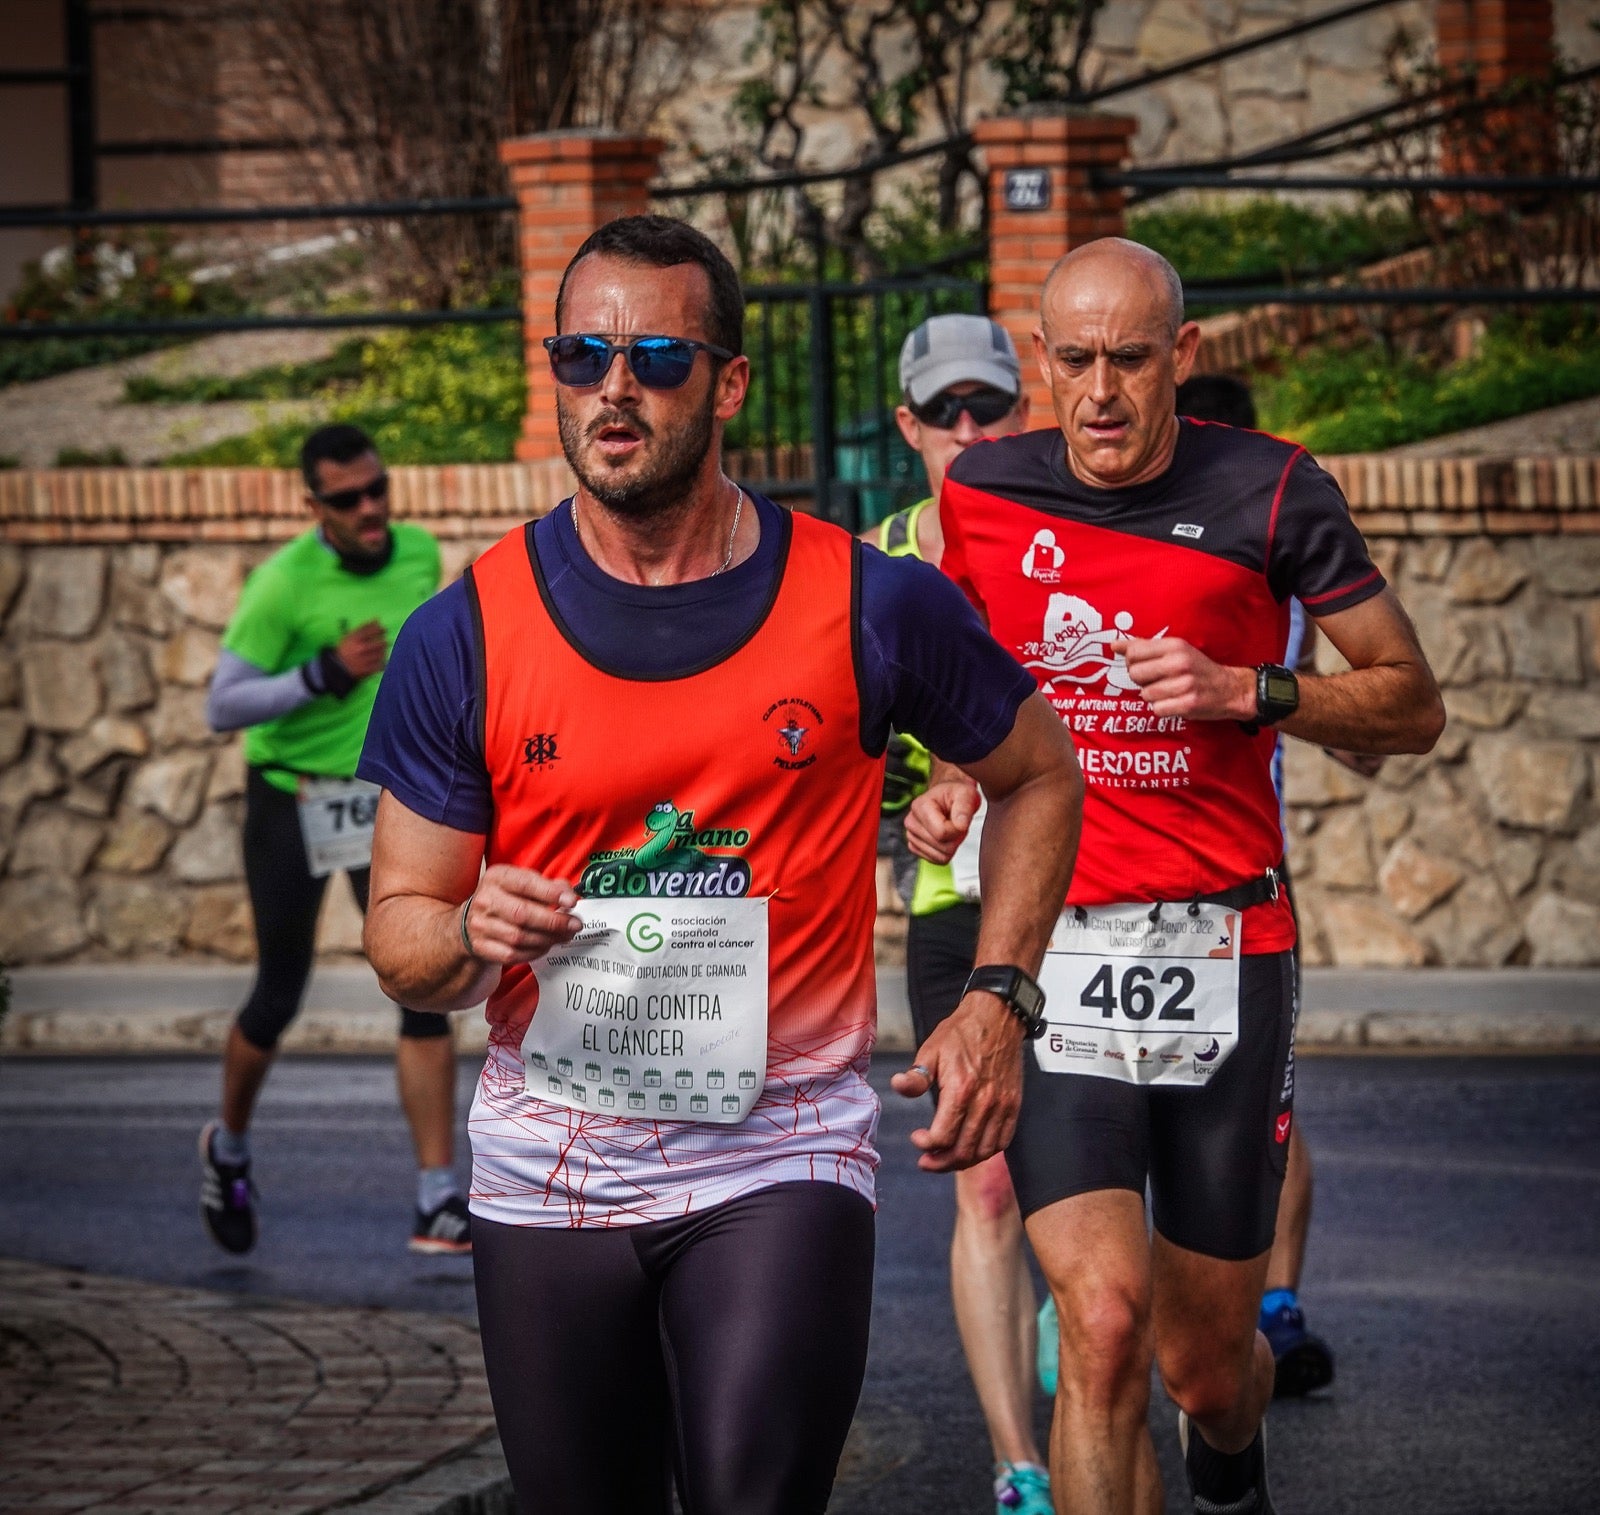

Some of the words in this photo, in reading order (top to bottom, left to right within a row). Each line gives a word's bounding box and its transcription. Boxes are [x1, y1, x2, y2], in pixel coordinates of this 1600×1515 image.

[1074, 714, 1098, 732] DE
[674, 828, 749, 849] mano
[589, 847, 636, 862] ocasión
[671, 915, 726, 926] asociación
[1190, 919, 1214, 935] 2022
[671, 928, 719, 940] española
[671, 940, 705, 949] contra
[707, 940, 716, 949] el
[718, 939, 755, 949] cáncer
[571, 956, 600, 971] PREMIO
[601, 960, 611, 974] DE
[612, 961, 635, 978] FONDO
[636, 963, 689, 980] DIPUTACIÓN
[691, 965, 703, 978] DE
[706, 964, 748, 978] GRANADA
[1080, 964, 1195, 1021] 462
[565, 982, 584, 1012] YO
[586, 987, 638, 1022] CORRO
[647, 993, 723, 1022] CONTRA
[583, 1023, 601, 1052] EL
[608, 1026, 684, 1057] CÁNCER
